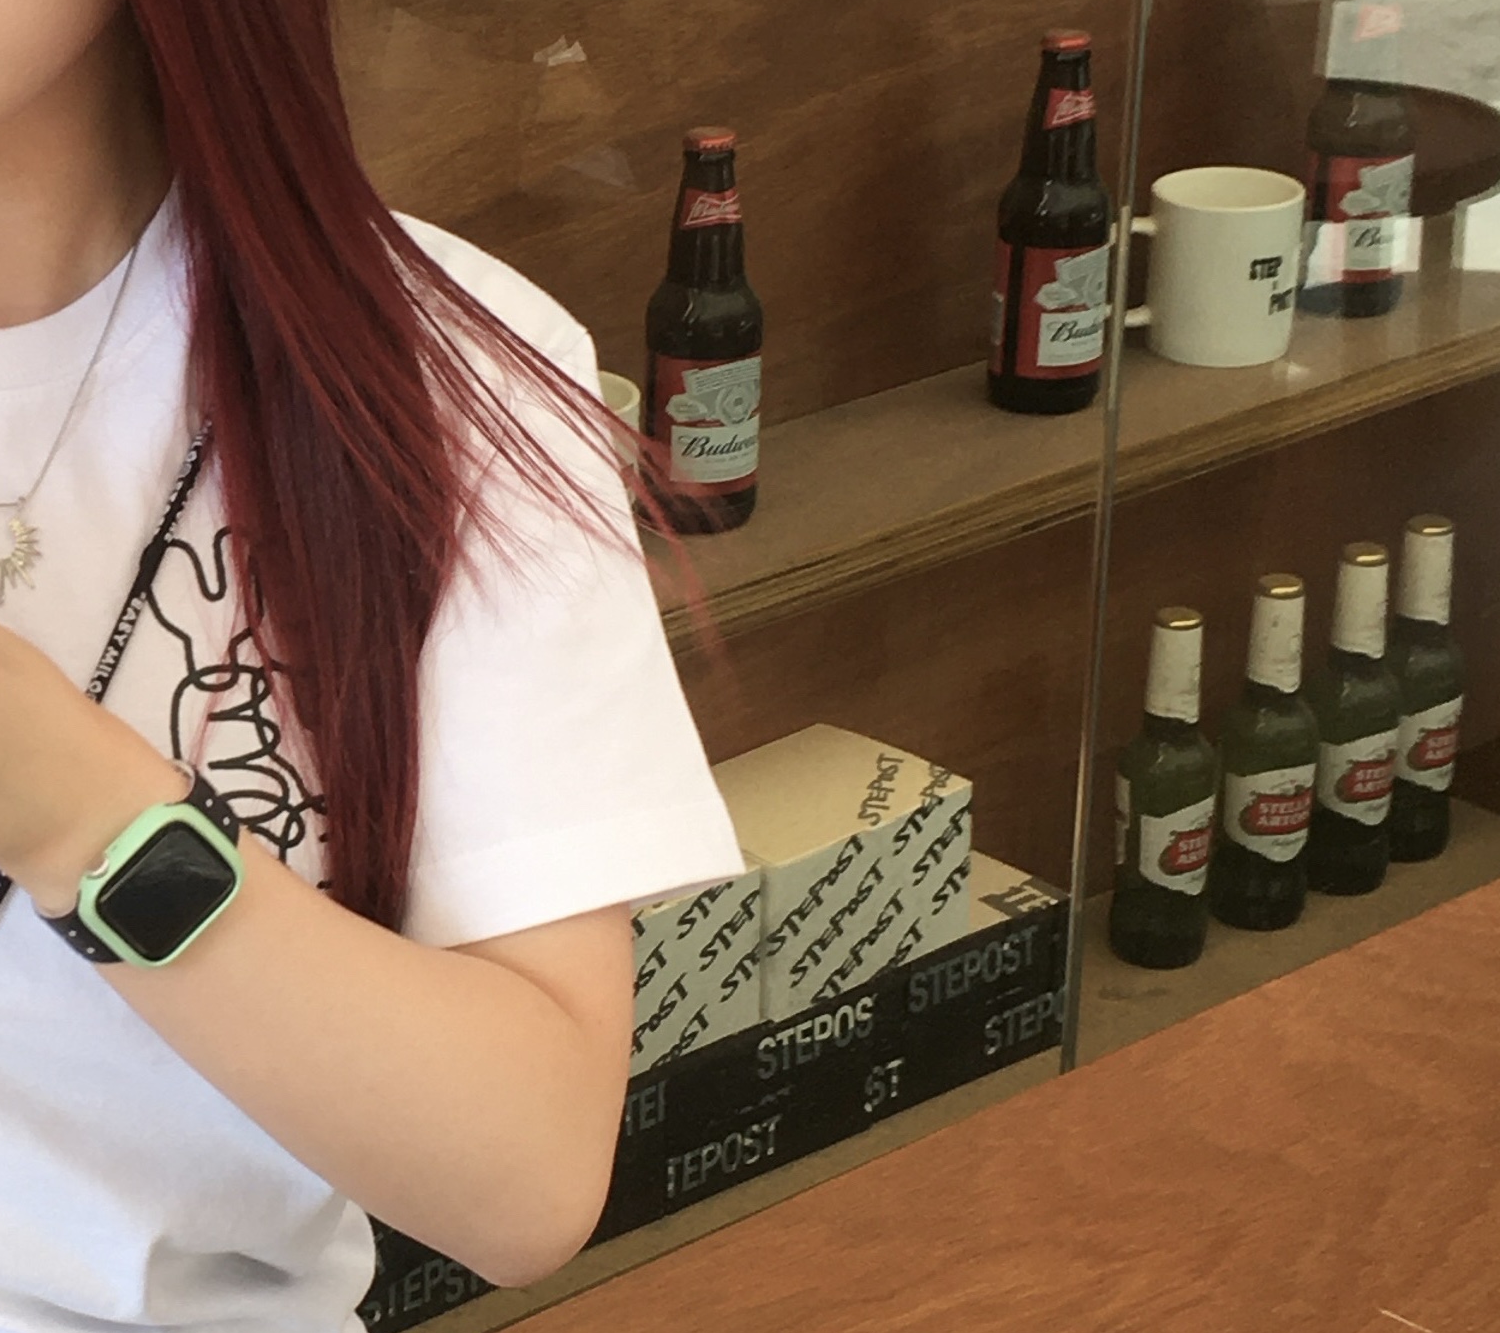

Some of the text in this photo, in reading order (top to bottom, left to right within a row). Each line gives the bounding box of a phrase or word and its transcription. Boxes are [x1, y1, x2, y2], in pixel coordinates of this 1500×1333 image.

[857, 752, 905, 827] STEPOST
[765, 833, 865, 957] STEPOST
[789, 856, 885, 989] STEPOST
[908, 924, 1039, 1014] STEPOST
